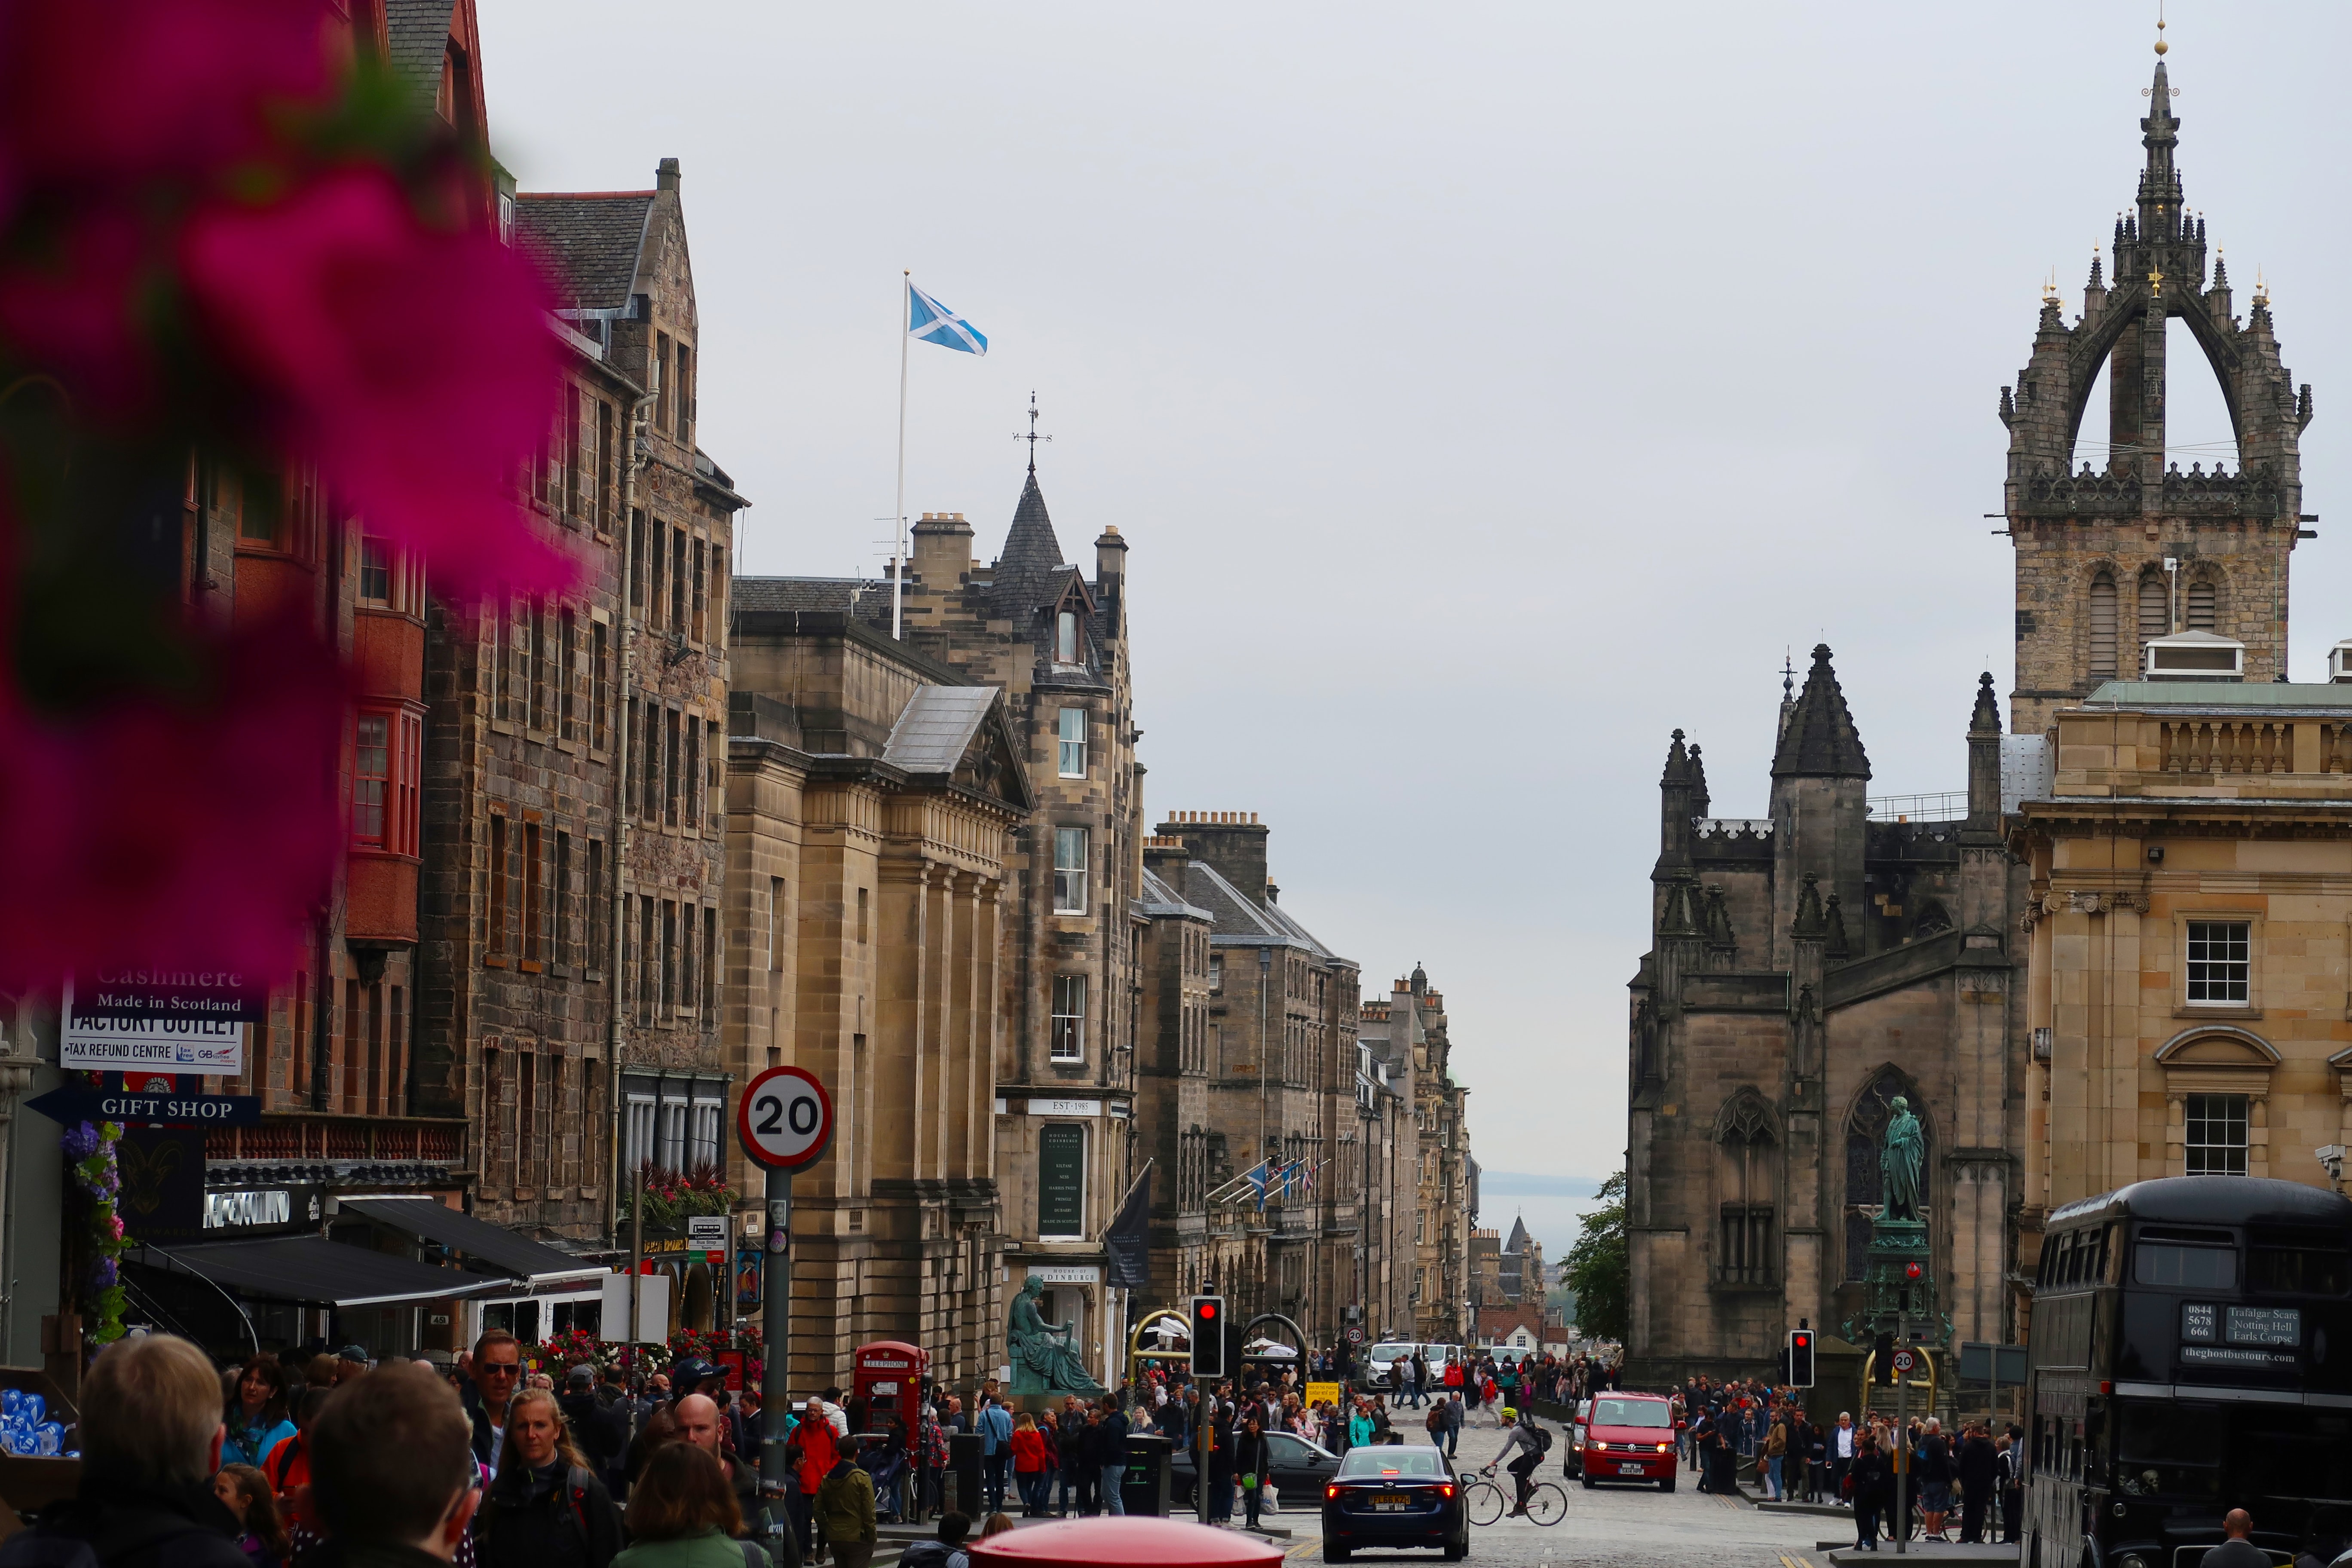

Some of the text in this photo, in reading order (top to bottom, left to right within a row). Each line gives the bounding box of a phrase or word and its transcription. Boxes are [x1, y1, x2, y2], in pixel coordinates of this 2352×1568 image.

[97, 964, 242, 987] Cashmere
[98, 994, 241, 1012] Made in Scotland
[69, 1043, 171, 1059] TAX REFUND CENTRE
[101, 1099, 233, 1118] GIFT SHOP
[756, 1095, 818, 1135] 20
[2188, 1305, 2298, 1320] 0844 Trafalgar Scare
[2188, 1316, 2292, 1332] 5678 Notting Hell
[2191, 1327, 2293, 1344] 666 Earls Corpse
[1896, 1357, 1911, 1366] 20
[2185, 1348, 2295, 1363] theghostbustours.com
